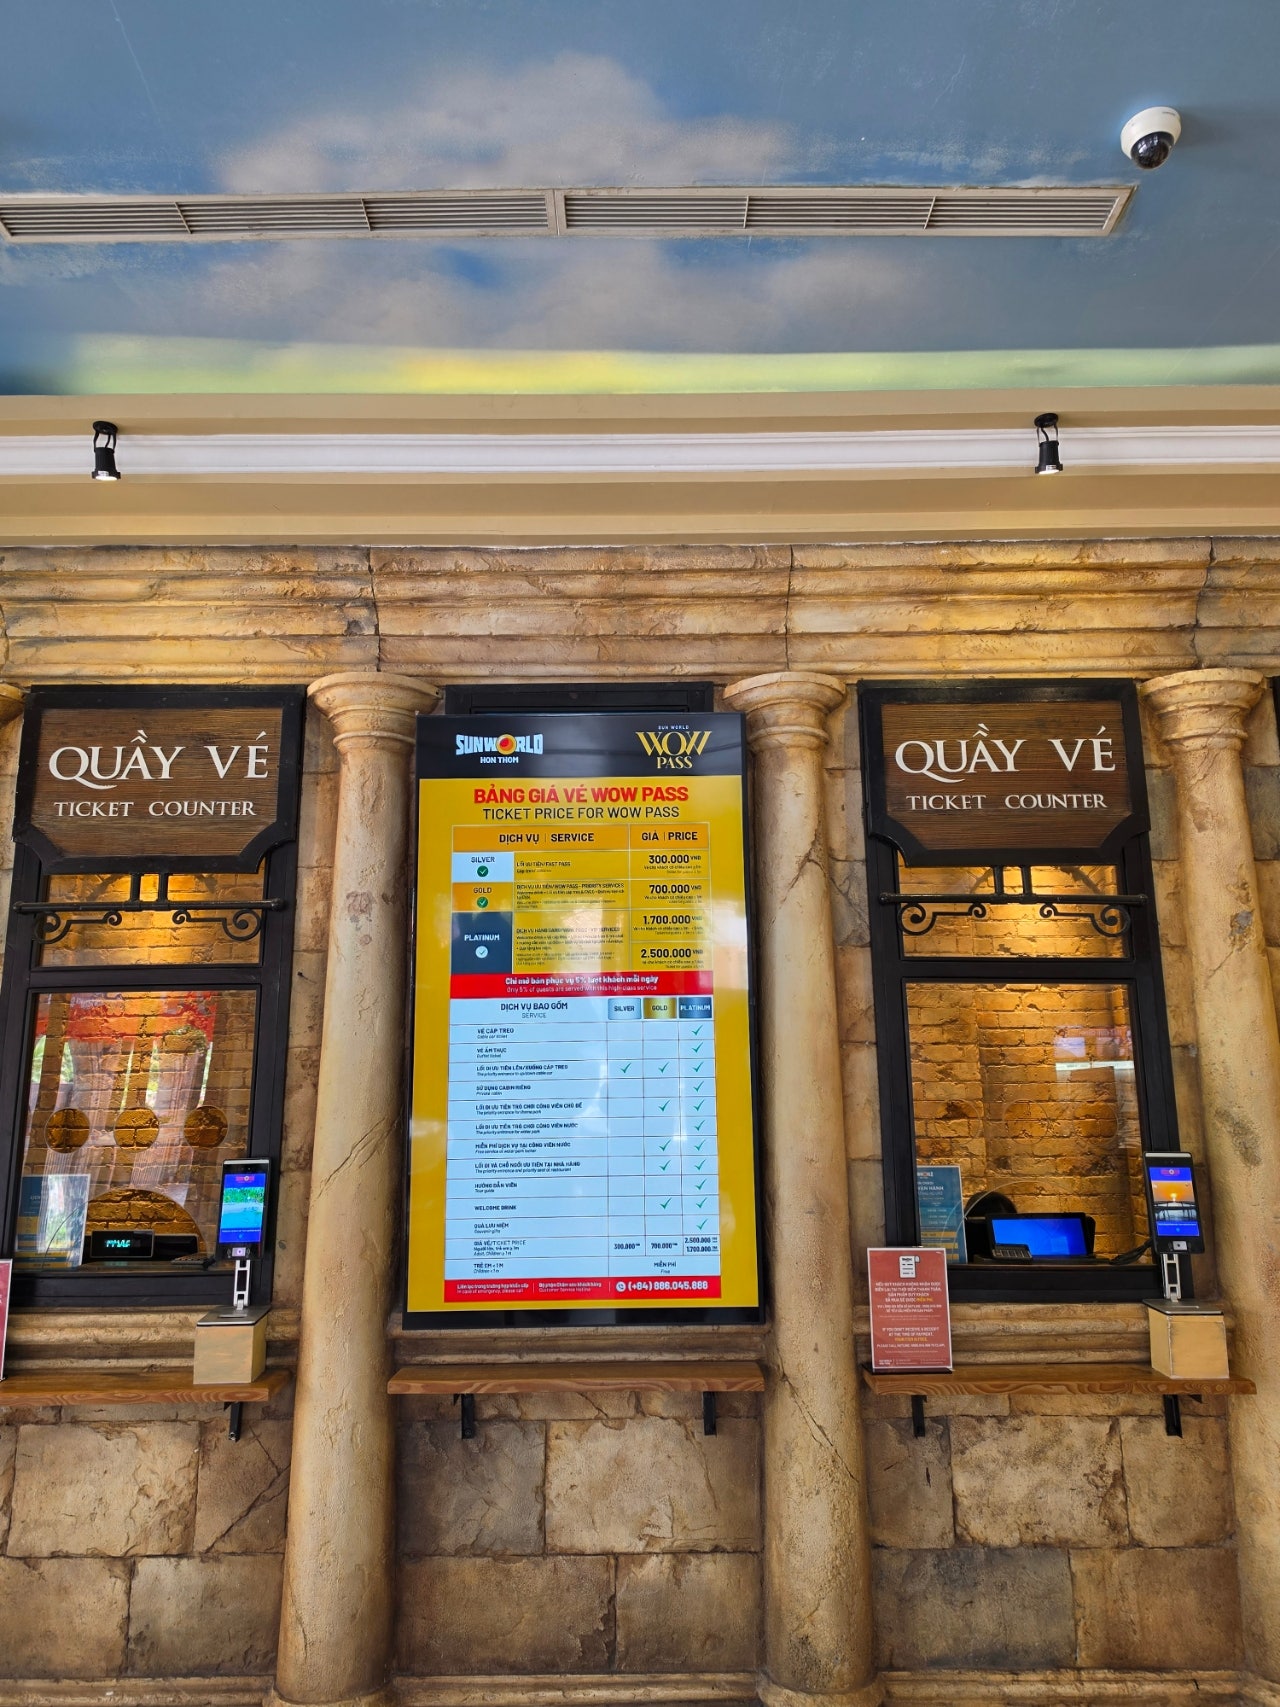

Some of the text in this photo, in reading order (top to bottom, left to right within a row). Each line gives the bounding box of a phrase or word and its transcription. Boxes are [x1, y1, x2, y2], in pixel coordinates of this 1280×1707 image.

[635, 731, 712, 756] WOW
[895, 723, 1116, 783] QUẦY VÉ
[49, 730, 269, 790] QUẦY VÉ
[480, 756, 519, 764] HON THOM
[657, 756, 693, 769] PASS
[474, 784, 689, 804] BẢNG GIÁ VÉ WOW PASS
[906, 794, 1108, 810] TICKET COUNTER
[54, 801, 257, 817] TICKET COUNTER
[483, 807, 680, 820] TICKET PRICE FOR WOW PASS
[499, 833, 594, 845] DỊCH VỤ SERVICE
[642, 830, 698, 841] GIÁ PRICE
[649, 855, 689, 864] 300.000
[649, 885, 690, 894] 700.000
[643, 915, 691, 925] 1.700.000
[641, 949, 691, 958] 2.500.000
[531, 977, 545, 985] bán
[546, 977, 564, 986] phục
[641, 976, 659, 984] ngày
[501, 1003, 519, 1012] DỊCH
[521, 1003, 532, 1012] VỤ
[680, 1004, 711, 1012] PLATINUM
[628, 1281, 653, 1292] (+84)
